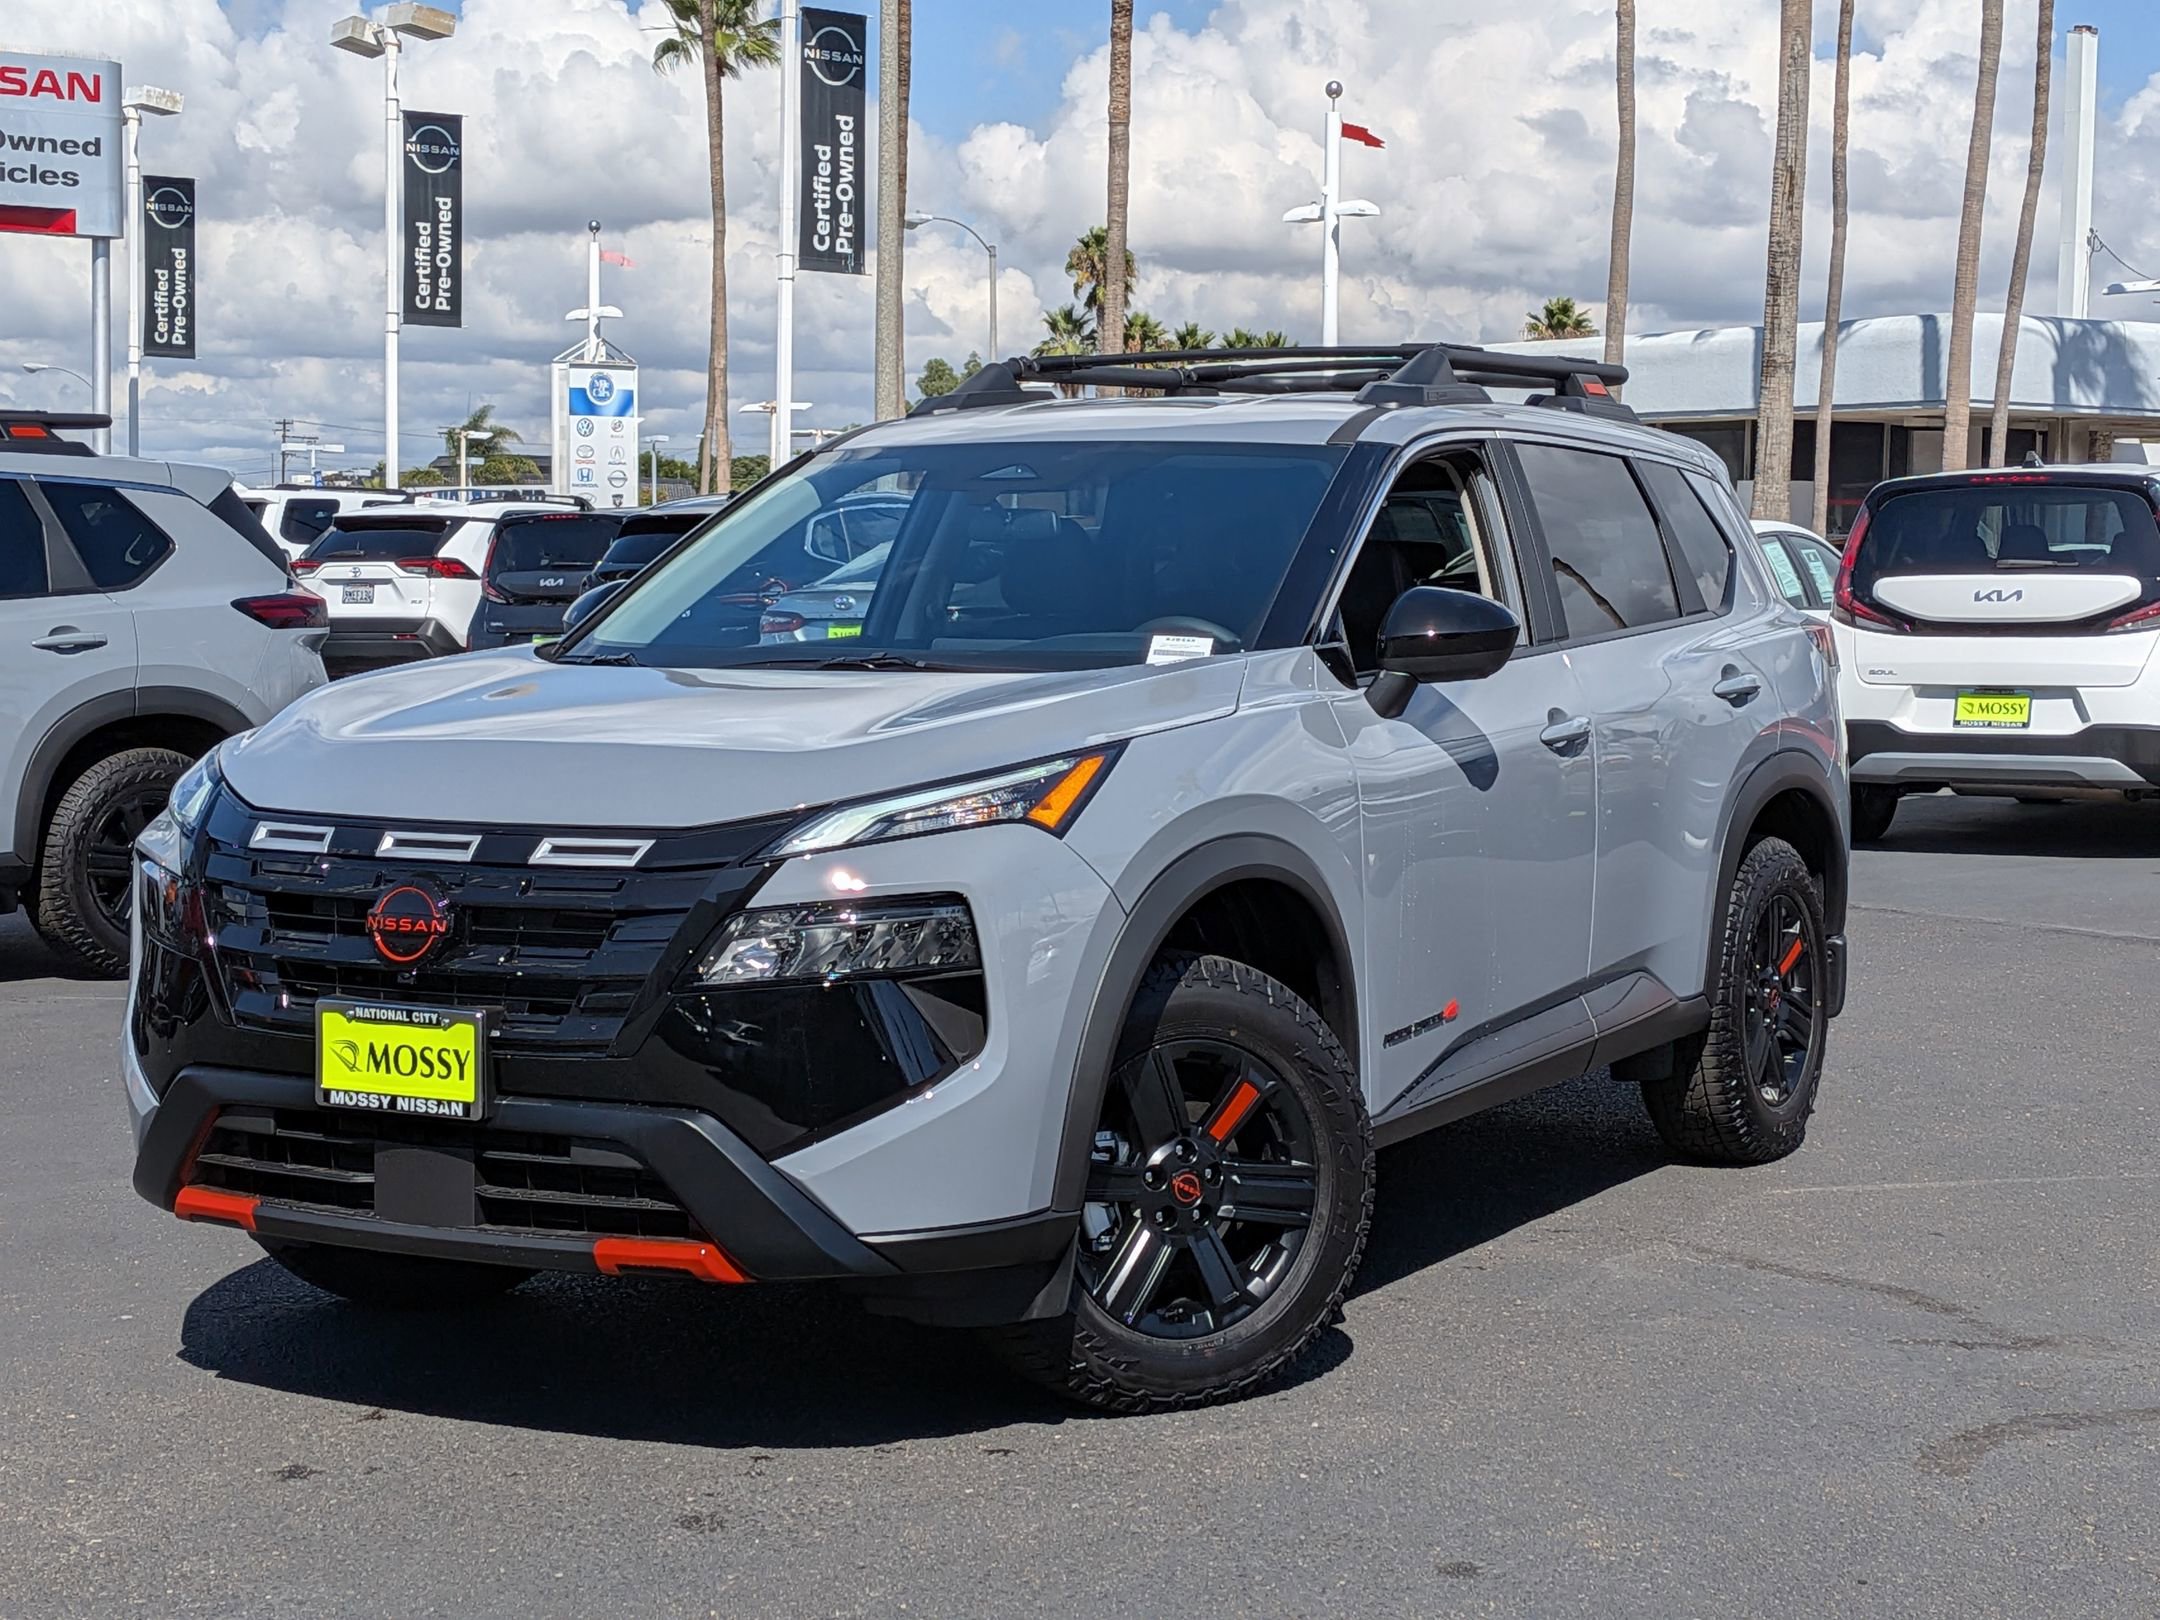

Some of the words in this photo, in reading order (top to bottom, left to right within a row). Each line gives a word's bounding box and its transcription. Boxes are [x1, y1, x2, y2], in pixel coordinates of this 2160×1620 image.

[804, 47, 863, 65] NISSAN
[406, 142, 460, 156] NISSAN
[813, 144, 832, 251] Certified
[836, 114, 854, 255] Pre-Owned
[146, 202, 193, 214] NISSAN
[415, 221, 432, 309] Certified
[435, 196, 452, 310] Pre-Owned
[154, 268, 169, 344] Certified
[171, 247, 186, 345] Pre-Owned
[1978, 702, 2027, 715] MOSSY
[1959, 719, 1990, 727] MOSSY
[1991, 720, 2023, 728] NISSAN
[367, 915, 448, 933] NISSAN
[354, 1006, 409, 1022] NATIONAL
[411, 1012, 440, 1025] CITY
[366, 1040, 471, 1081] MOSSY
[329, 1090, 392, 1110] MOSSY
[396, 1097, 464, 1117] NISSAN
